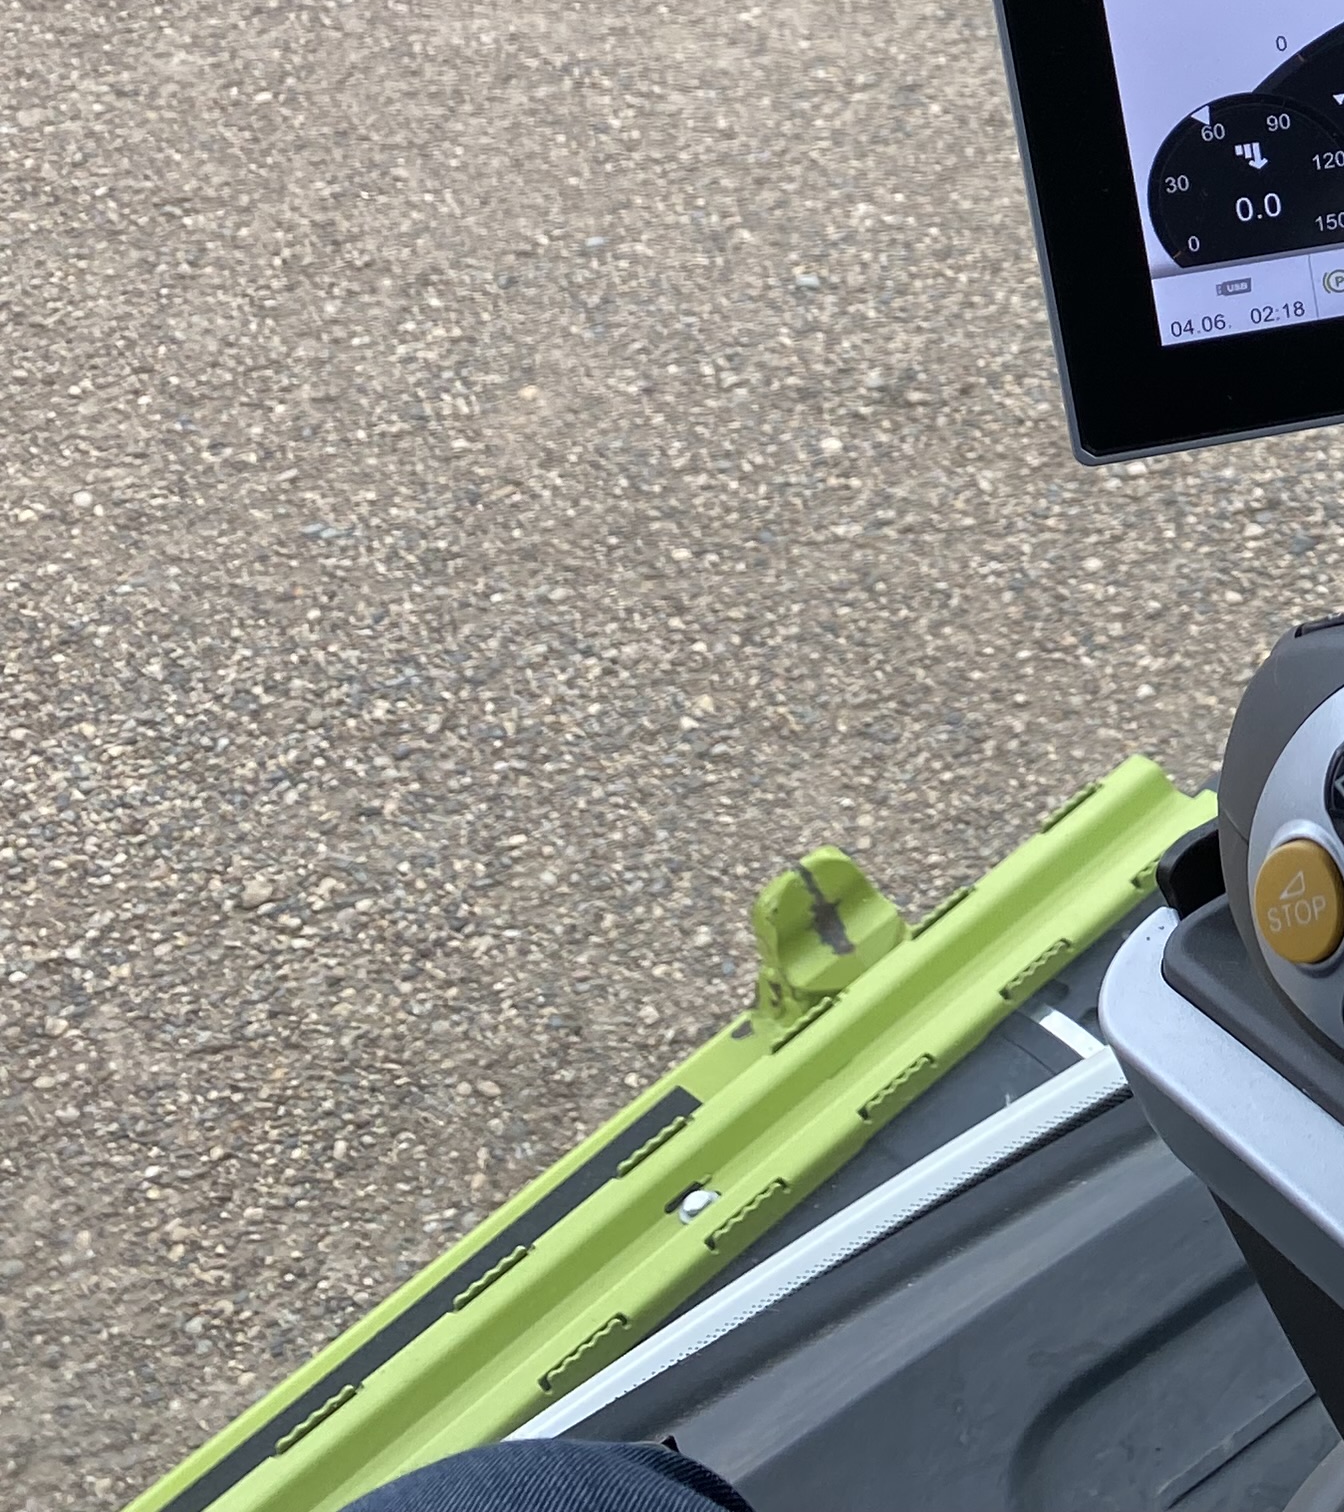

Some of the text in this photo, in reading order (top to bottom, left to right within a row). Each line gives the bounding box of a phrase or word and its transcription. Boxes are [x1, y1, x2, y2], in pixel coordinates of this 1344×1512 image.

[1275, 35, 1288, 51] 0
[1266, 113, 1291, 131] 90
[1201, 123, 1225, 141] 60
[1165, 175, 1190, 193] 30
[1235, 193, 1282, 221] 0.0
[1187, 236, 1200, 253] 0
[1226, 282, 1248, 293] USB
[1334, 276, 1344, 287] P
[1171, 301, 1306, 338] 04.06. 02:18
[1267, 895, 1327, 934] STOP
